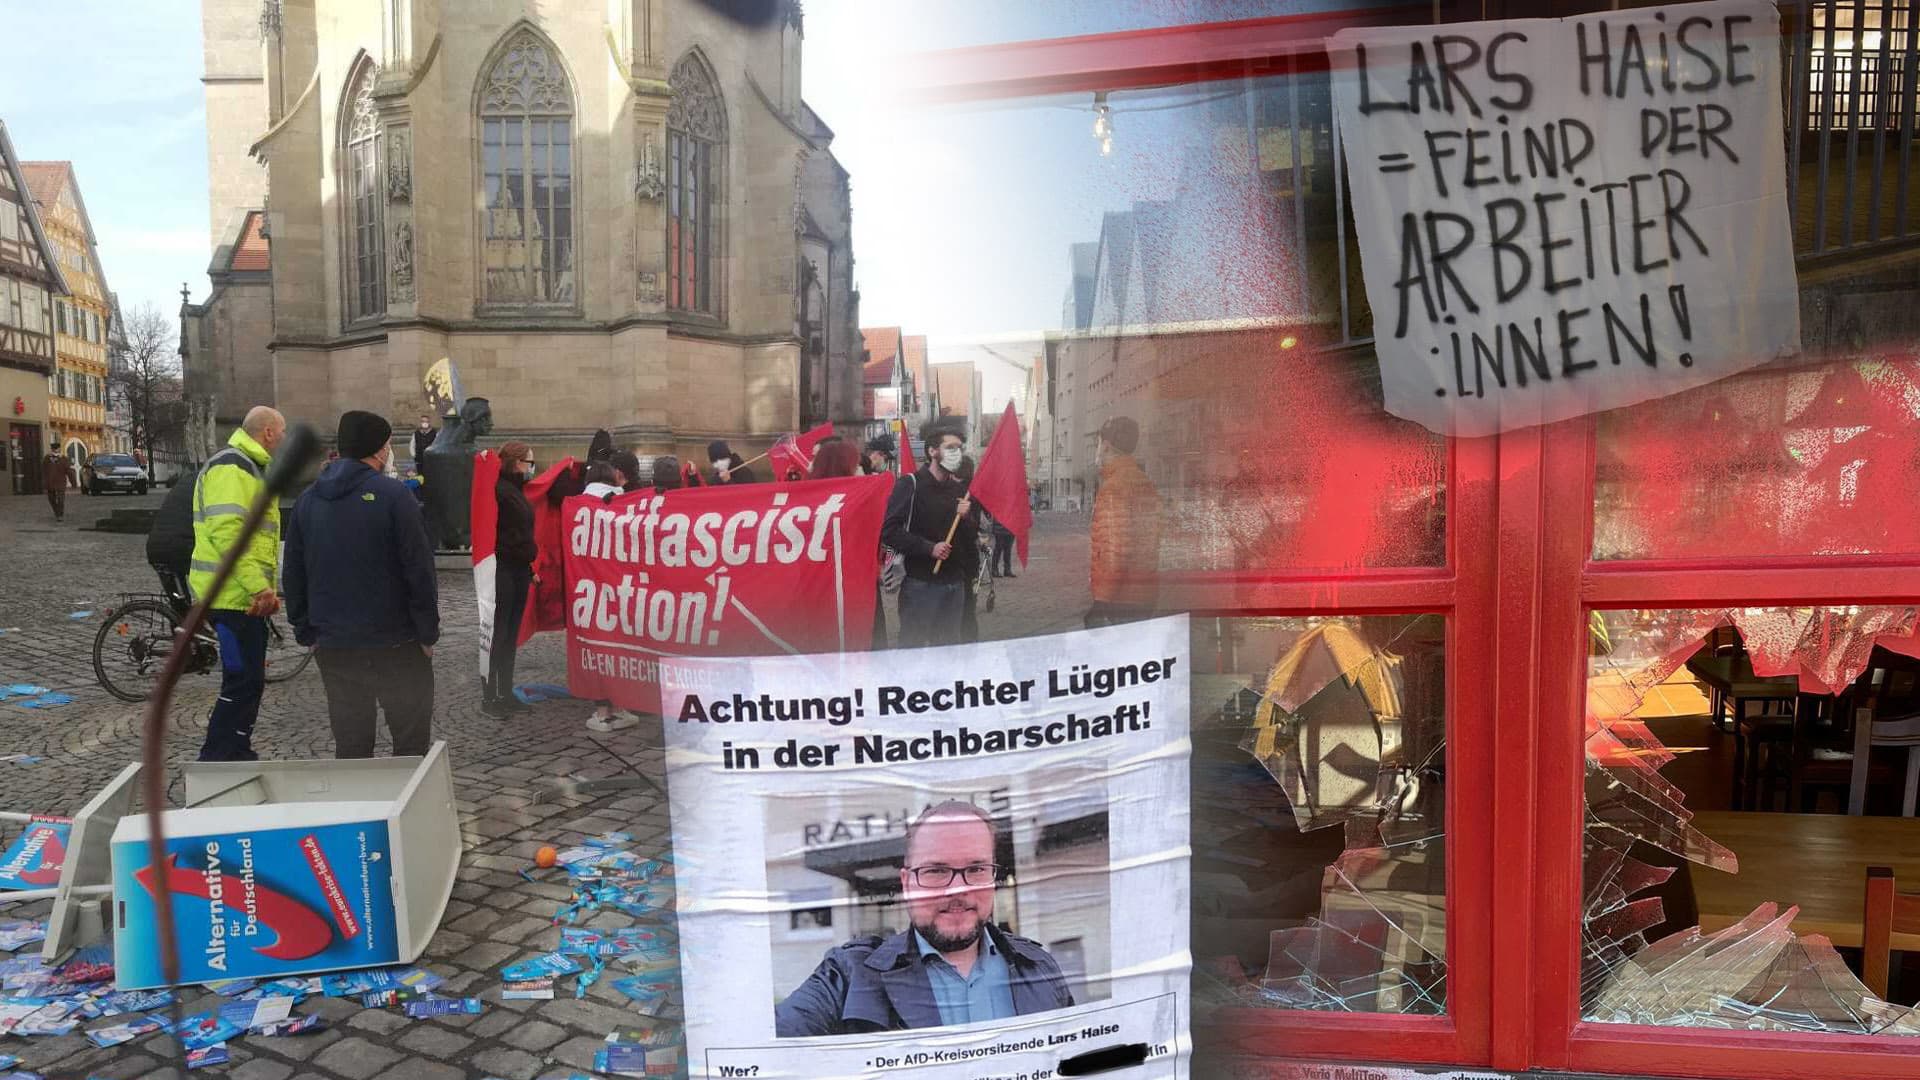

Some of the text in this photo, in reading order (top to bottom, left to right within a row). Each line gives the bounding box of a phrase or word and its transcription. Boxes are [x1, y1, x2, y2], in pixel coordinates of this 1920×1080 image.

[1357, 12, 1755, 118] LARS HAISE
[1640, 103, 1740, 164] DER
[1394, 168, 1709, 339] ARBEITER
[570, 492, 847, 569] antifascist
[572, 570, 732, 647] action!
[678, 657, 1177, 726] Achtung! Rechter Lügner
[723, 701, 1151, 769] in der Nachbarschaft!
[202, 840, 228, 972] Alternative
[237, 838, 258, 937] Deutschland
[230, 919, 242, 937] für
[719, 1065, 760, 1078] Wer?
[876, 1023, 1120, 1068] Der AfD-Kreisvorsitzende Lars Haise
[1031, 1069, 1054, 1080] der
